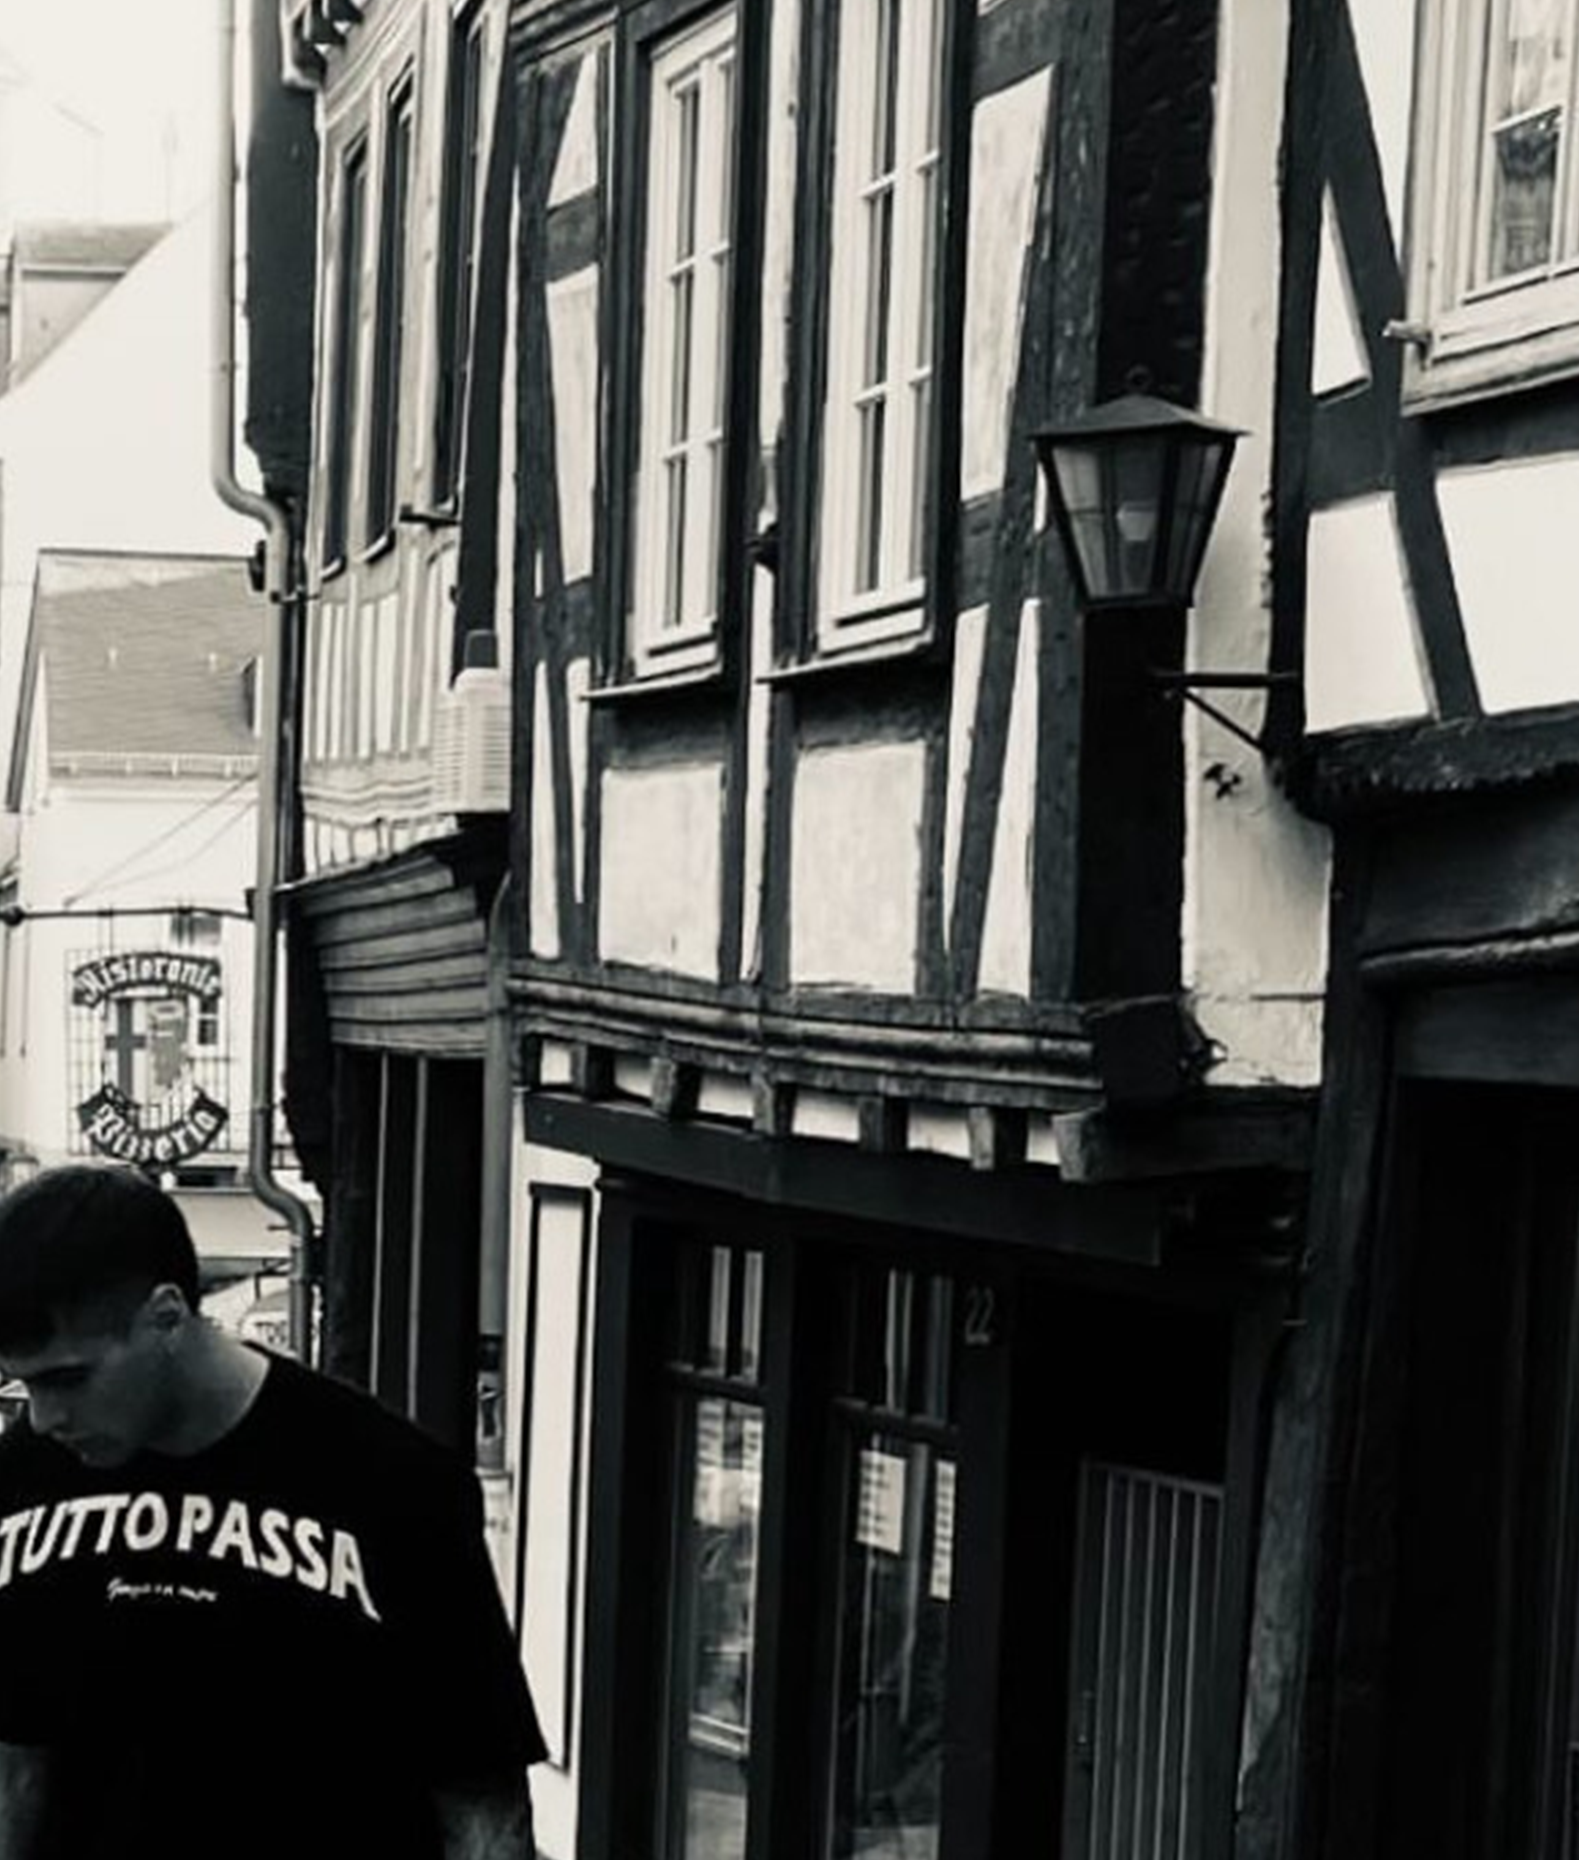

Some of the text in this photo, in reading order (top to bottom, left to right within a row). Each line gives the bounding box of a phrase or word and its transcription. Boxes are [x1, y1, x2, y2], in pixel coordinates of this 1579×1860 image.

[73, 957, 220, 1002] Ristorante
[86, 1103, 219, 1163] Pizzeria
[964, 1286, 995, 1346] 22
[175, 1493, 382, 1623] PASSA
